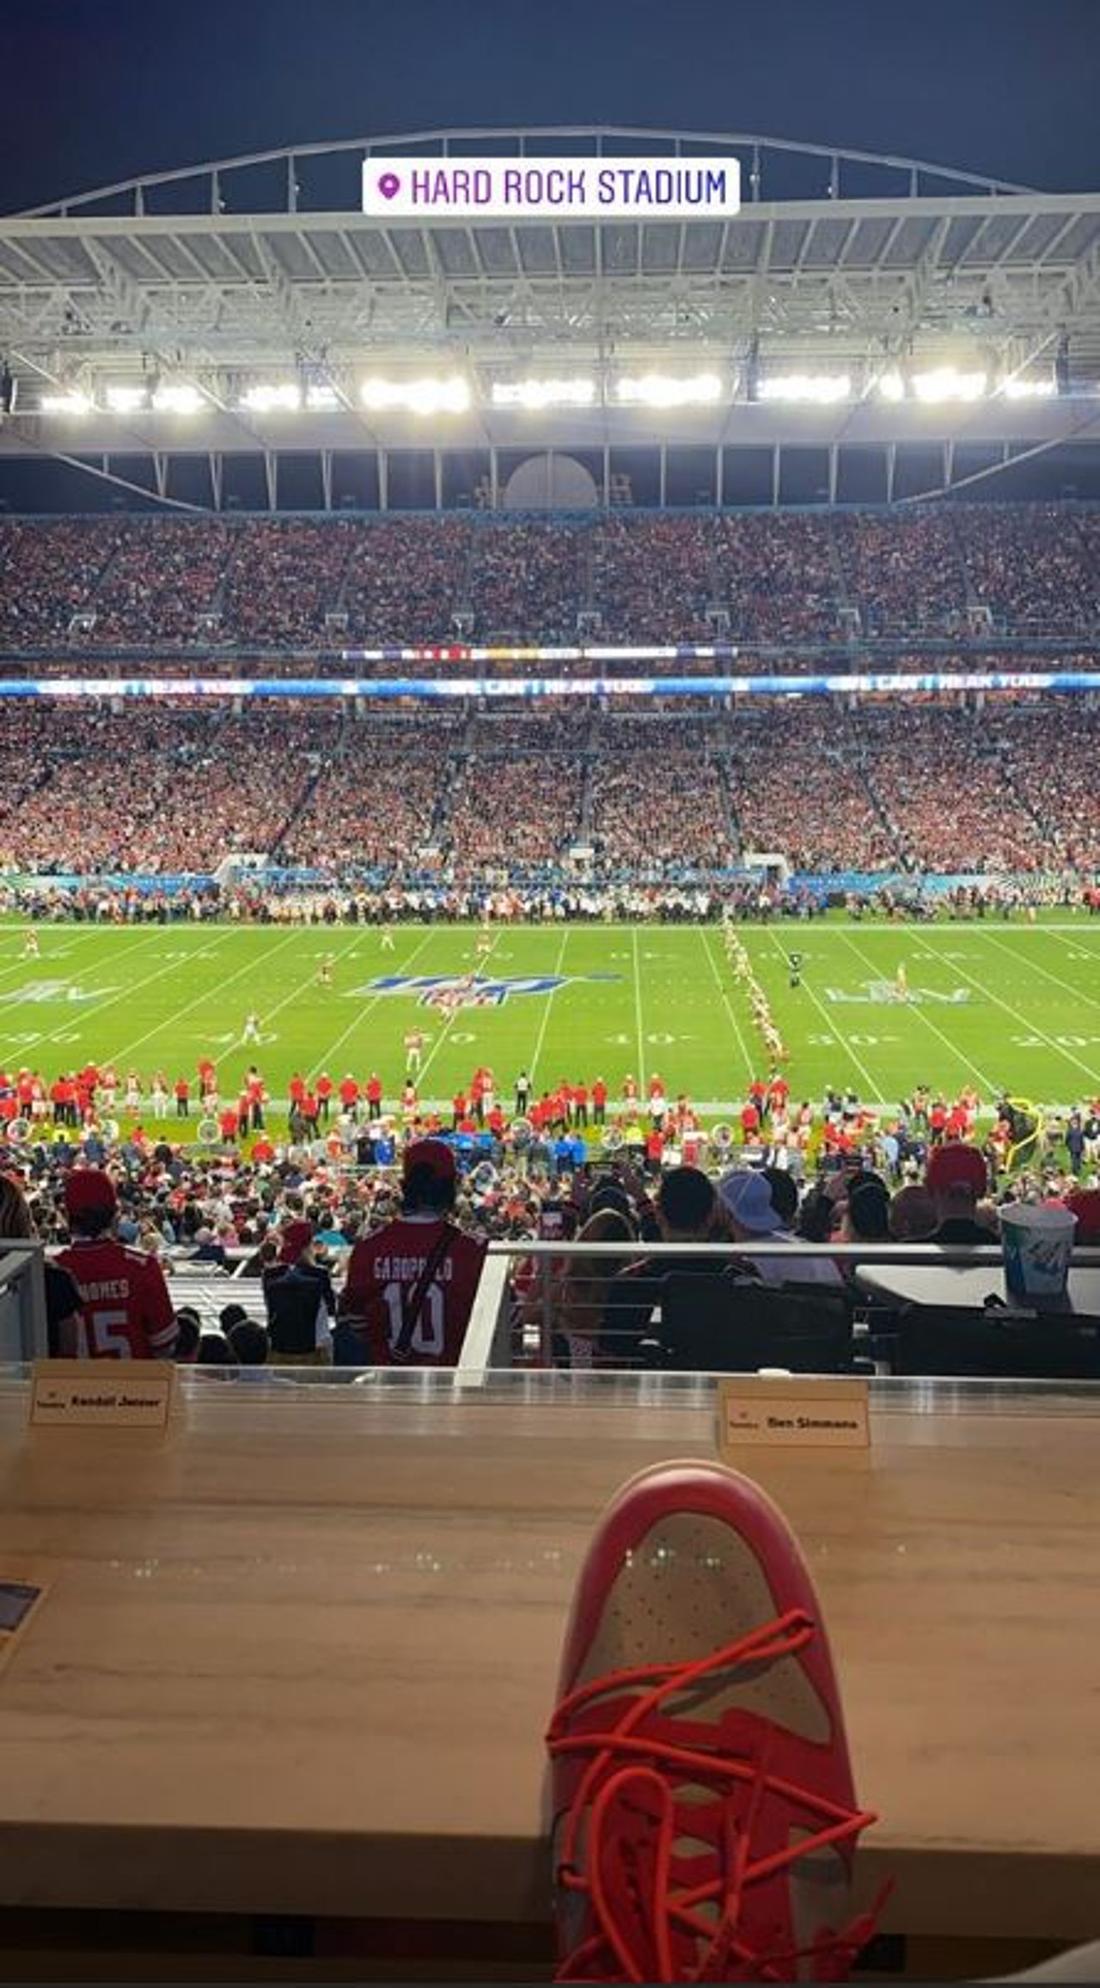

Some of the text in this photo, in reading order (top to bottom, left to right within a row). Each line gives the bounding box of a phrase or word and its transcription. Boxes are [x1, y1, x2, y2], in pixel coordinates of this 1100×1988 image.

[383, 1281, 444, 1356] 10
[71, 1395, 116, 1407] Kendall
[767, 1416, 795, 1429] Ben
